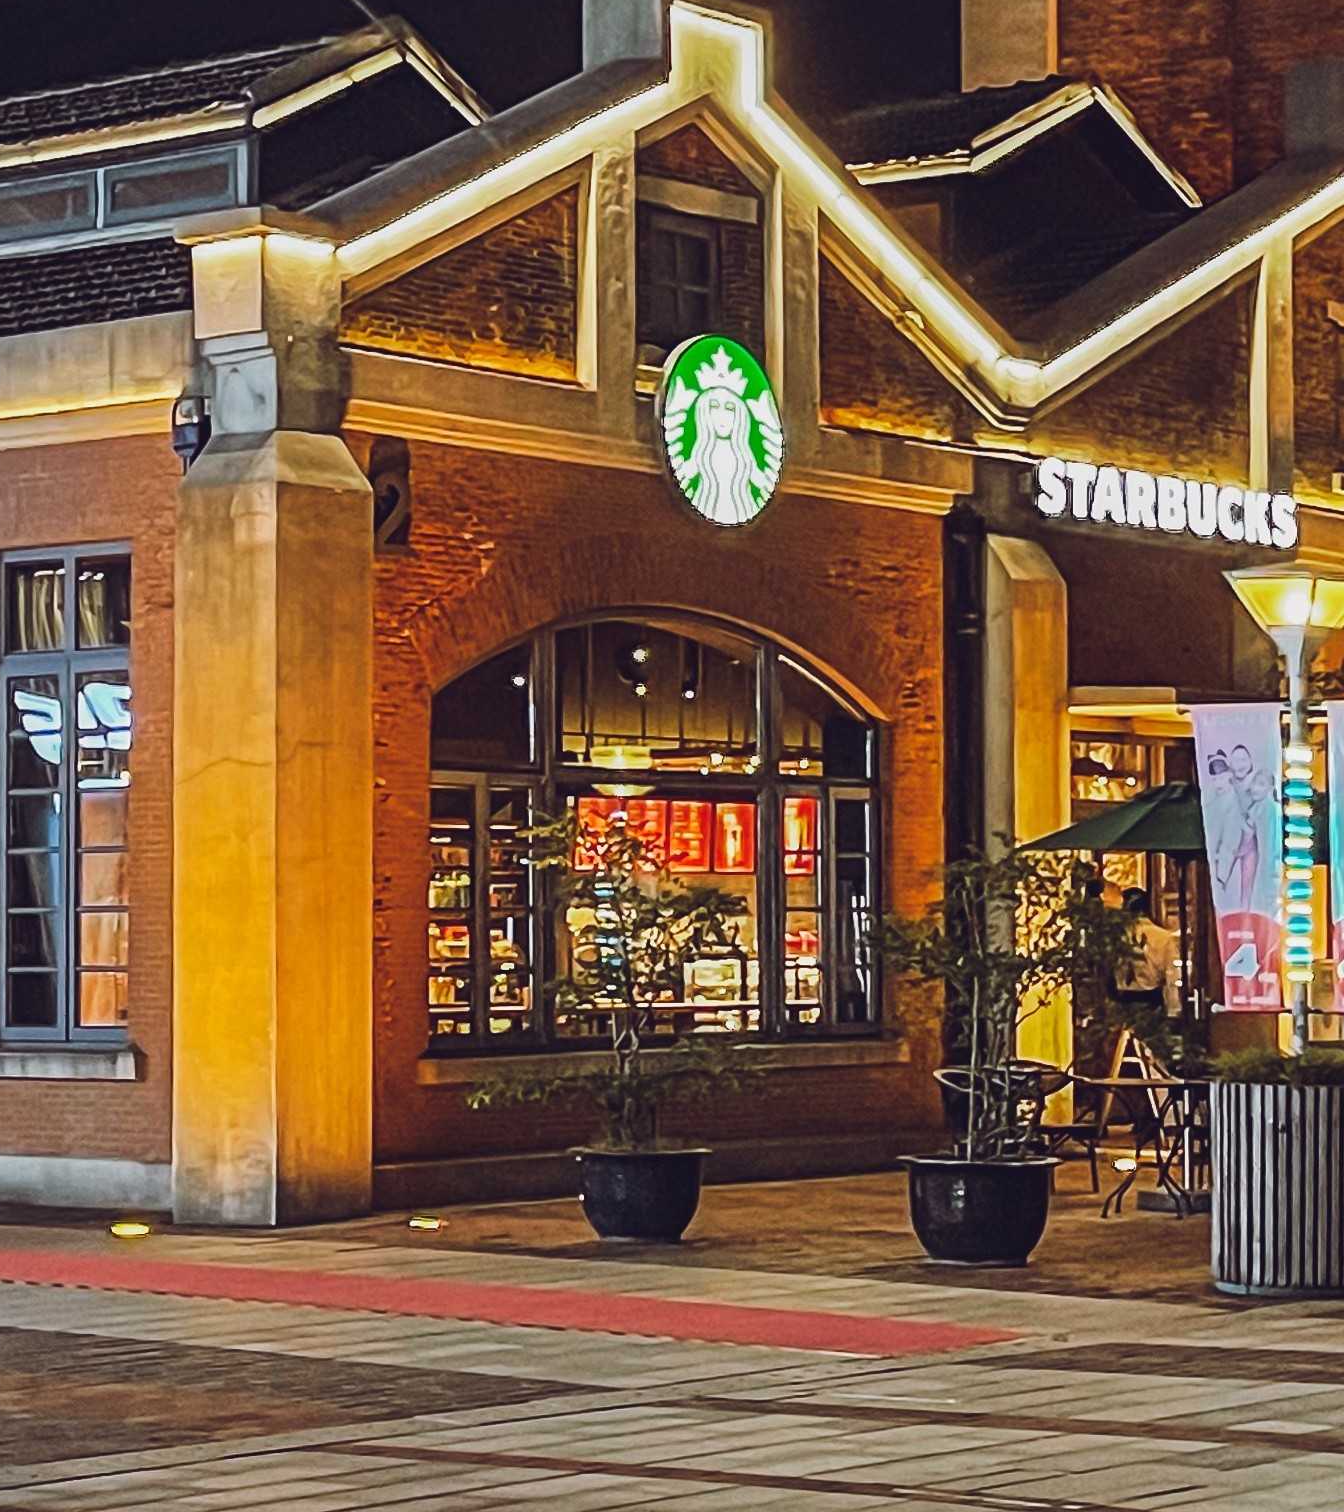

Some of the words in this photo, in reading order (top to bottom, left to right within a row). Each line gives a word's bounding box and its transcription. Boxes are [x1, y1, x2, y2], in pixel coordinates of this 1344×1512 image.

[375, 472, 409, 555] 2
[1037, 457, 1298, 549] STARBUCKS
[1225, 944, 1260, 980] 4
